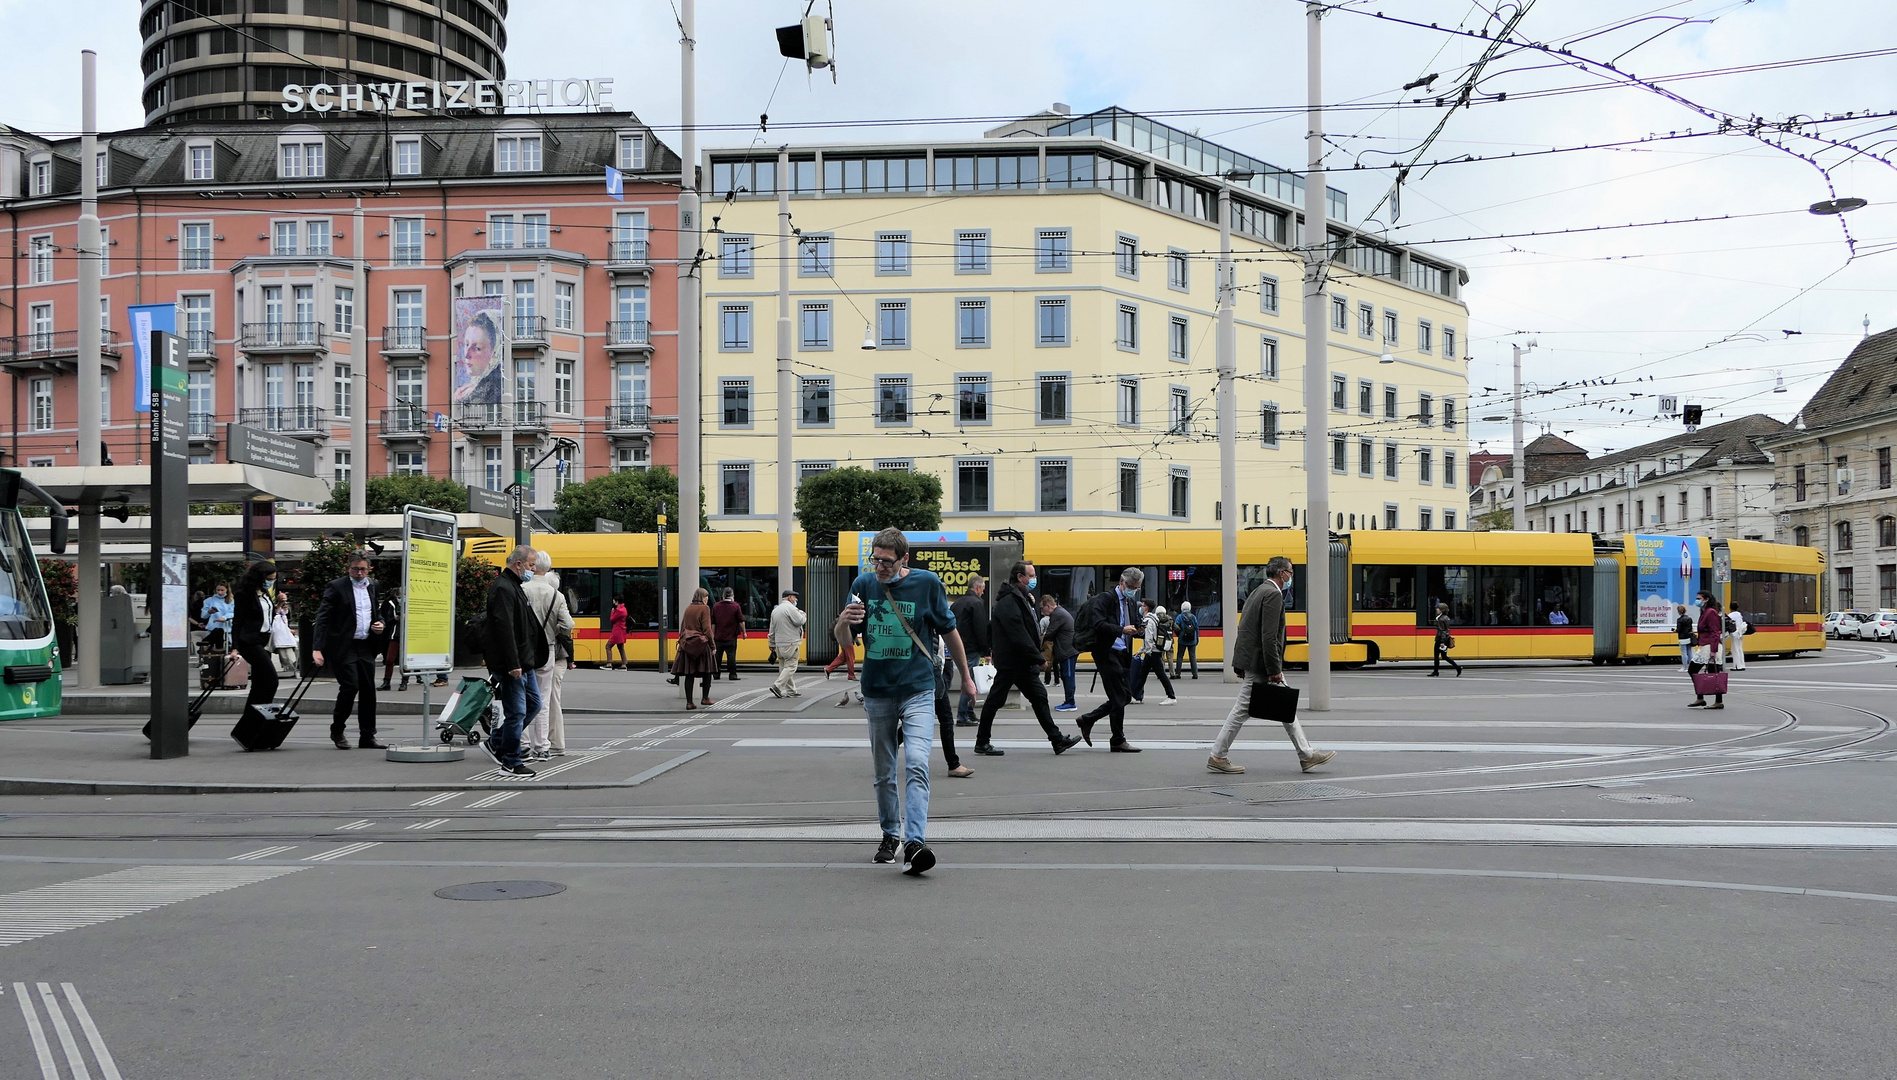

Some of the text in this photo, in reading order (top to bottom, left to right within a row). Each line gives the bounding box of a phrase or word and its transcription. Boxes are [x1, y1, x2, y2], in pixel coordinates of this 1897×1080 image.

[281, 77, 615, 113] SCHWEIZERHOF
[169, 338, 179, 367] E
[1661, 398, 1671, 411] 10
[152, 392, 160, 442] Bahnhof SBB
[247, 430, 250, 438] 1
[246, 441, 250, 450] 2
[523, 453, 529, 469] F
[1215, 501, 1273, 525] HTEL
[1638, 539, 1665, 548] READY
[916, 551, 955, 562] SPIEL,
[1639, 549, 1655, 557] FOR
[1640, 558, 1661, 566] TAKE
[1640, 567, 1659, 576] OFF?
[868, 624, 893, 635] OF THE
[881, 648, 910, 658] JUNGLE
